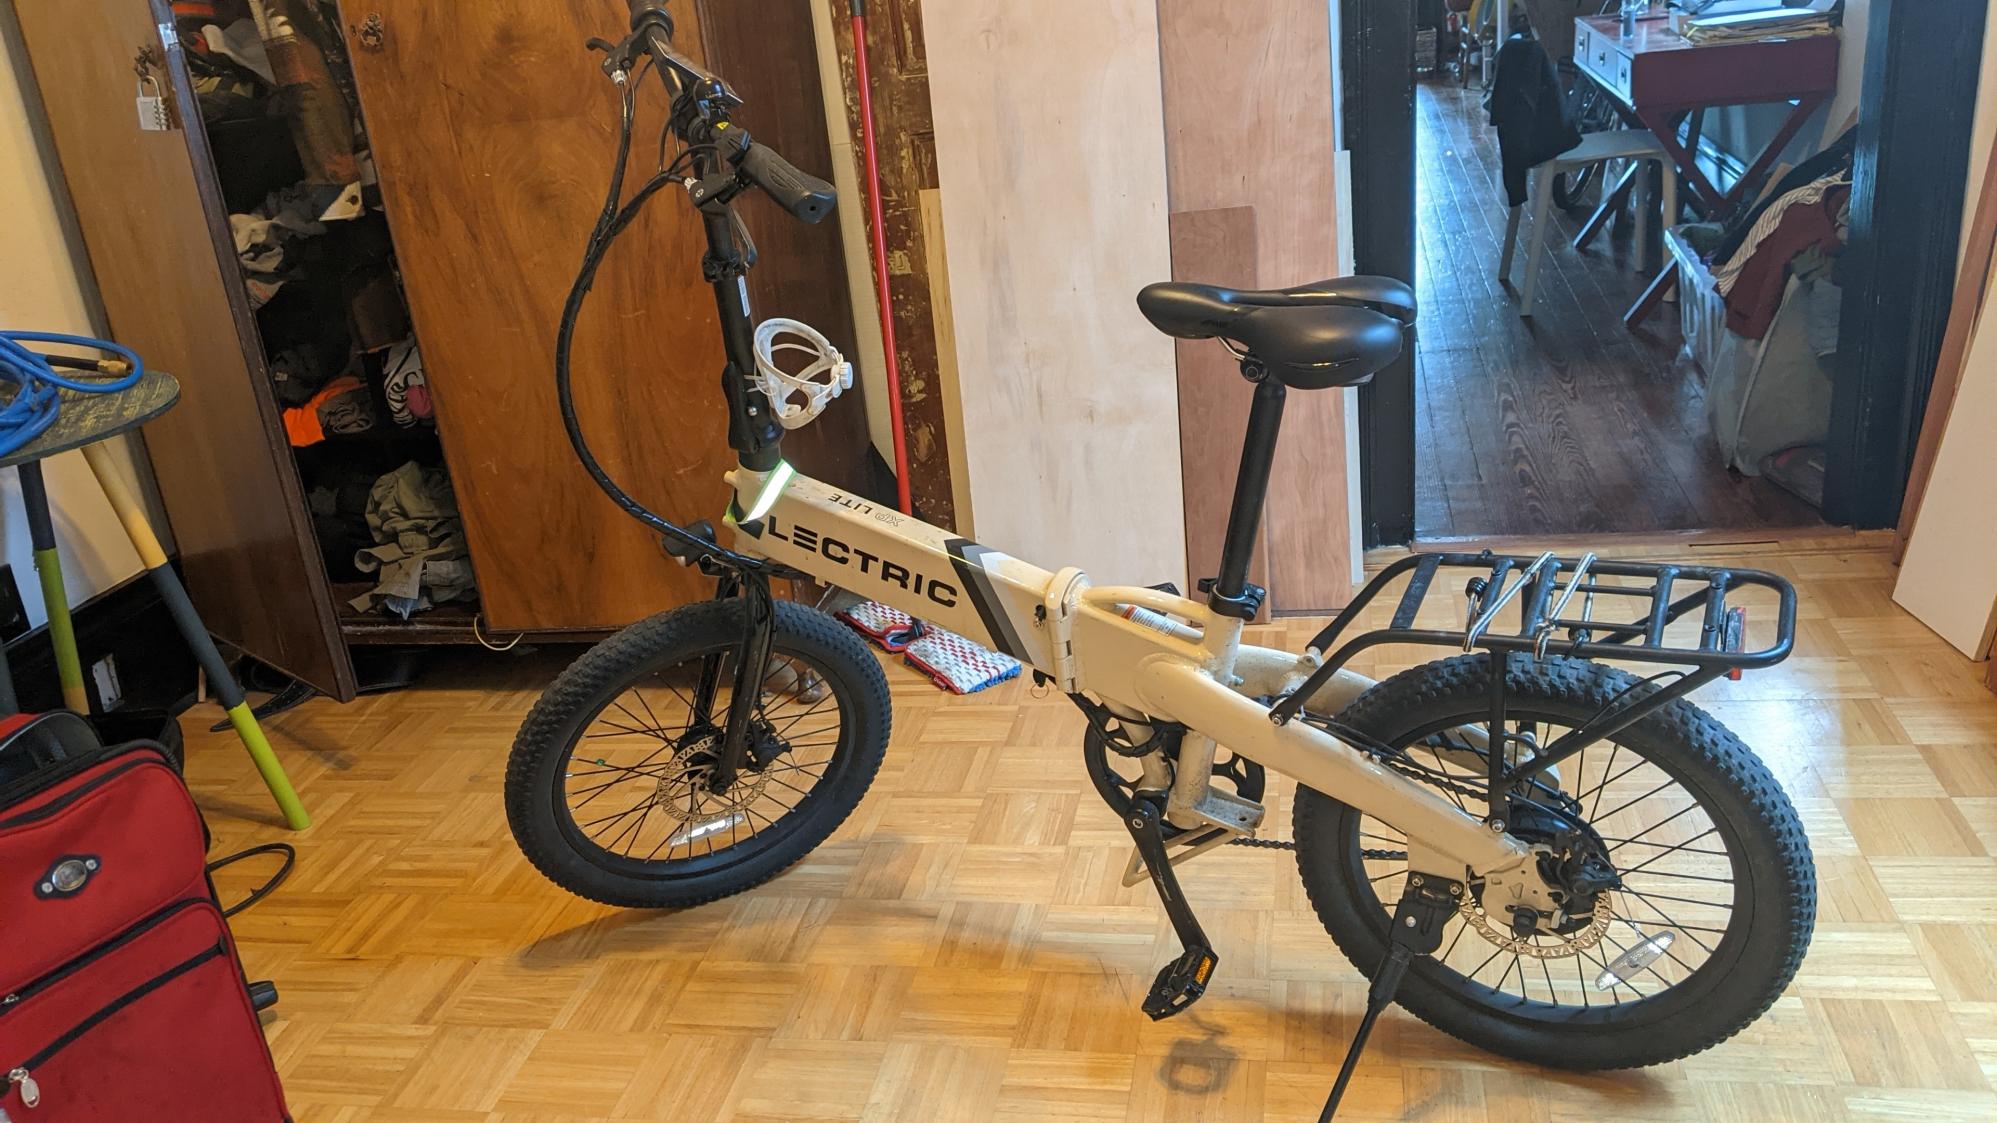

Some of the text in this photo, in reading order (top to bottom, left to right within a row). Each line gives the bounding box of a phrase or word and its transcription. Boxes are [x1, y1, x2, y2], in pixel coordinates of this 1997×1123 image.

[828, 493, 904, 527] XP LITE
[768, 515, 958, 608] LECTRIC
